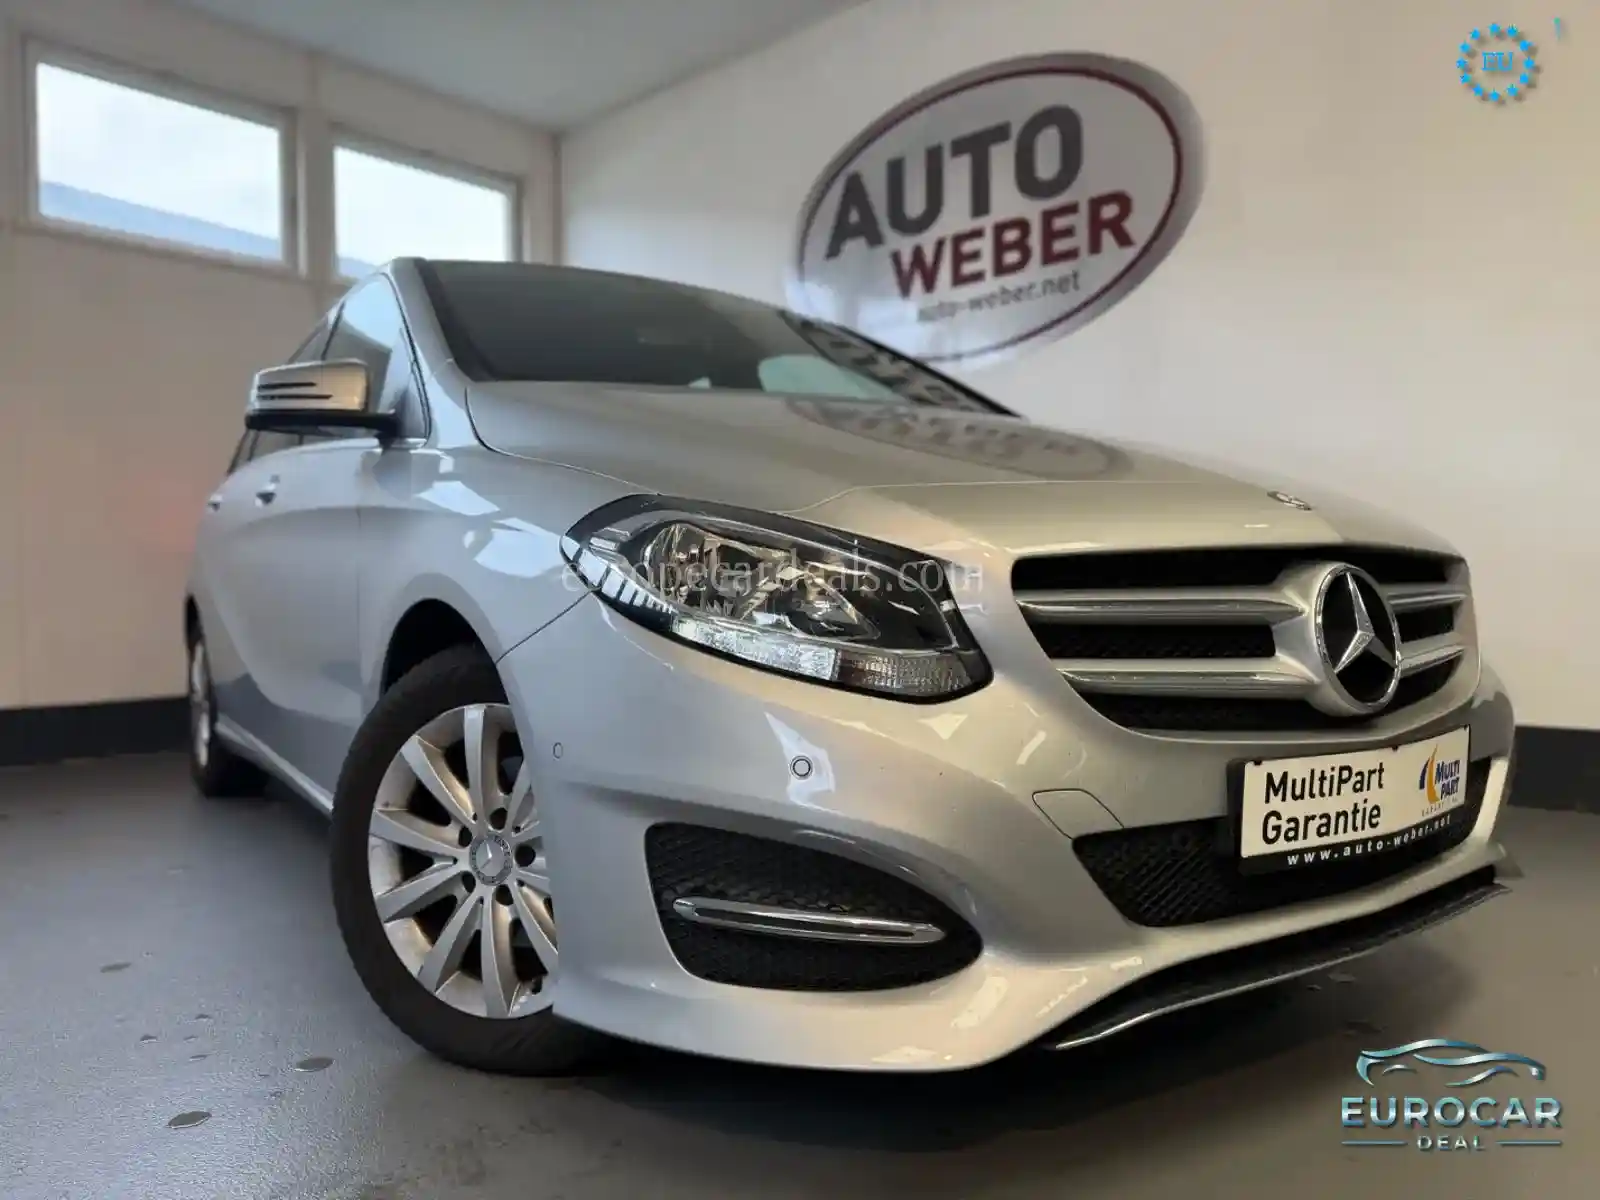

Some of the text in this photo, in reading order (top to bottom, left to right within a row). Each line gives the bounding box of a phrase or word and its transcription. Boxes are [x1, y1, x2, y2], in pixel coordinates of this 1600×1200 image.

[825, 105, 1083, 259] AUTO
[890, 190, 1135, 298] WEBER
[1262, 798, 1381, 845] Garantie
[1265, 762, 1384, 804] MultiPart
